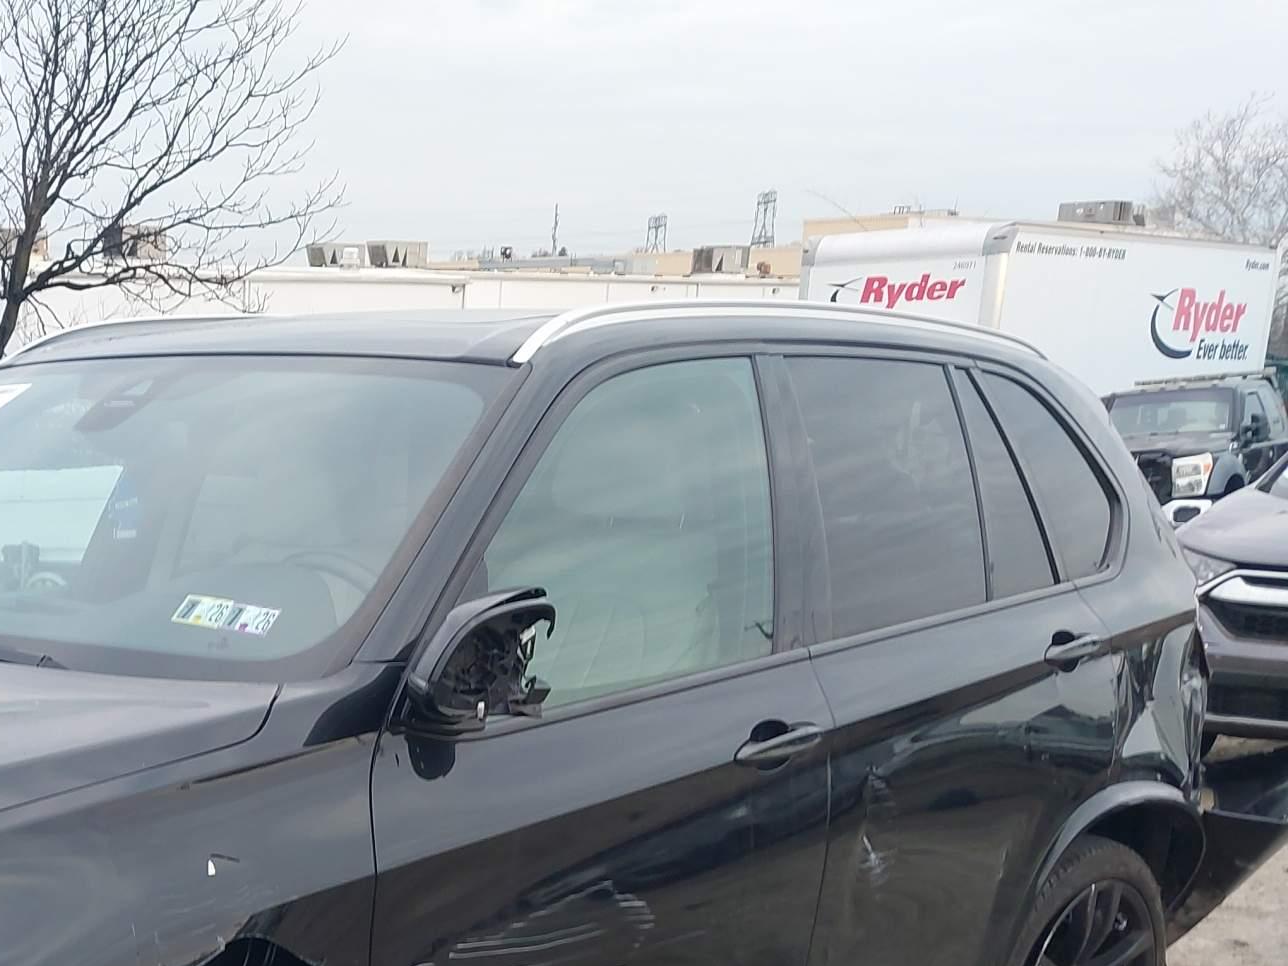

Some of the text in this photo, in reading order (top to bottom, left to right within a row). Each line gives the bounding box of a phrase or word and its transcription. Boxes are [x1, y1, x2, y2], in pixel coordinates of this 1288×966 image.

[1016, 241, 1037, 255] Rental
[860, 272, 967, 309] Ryder
[1173, 287, 1248, 343] Ryder
[1196, 339, 1250, 360] Ever better.
[255, 611, 277, 631] 26
